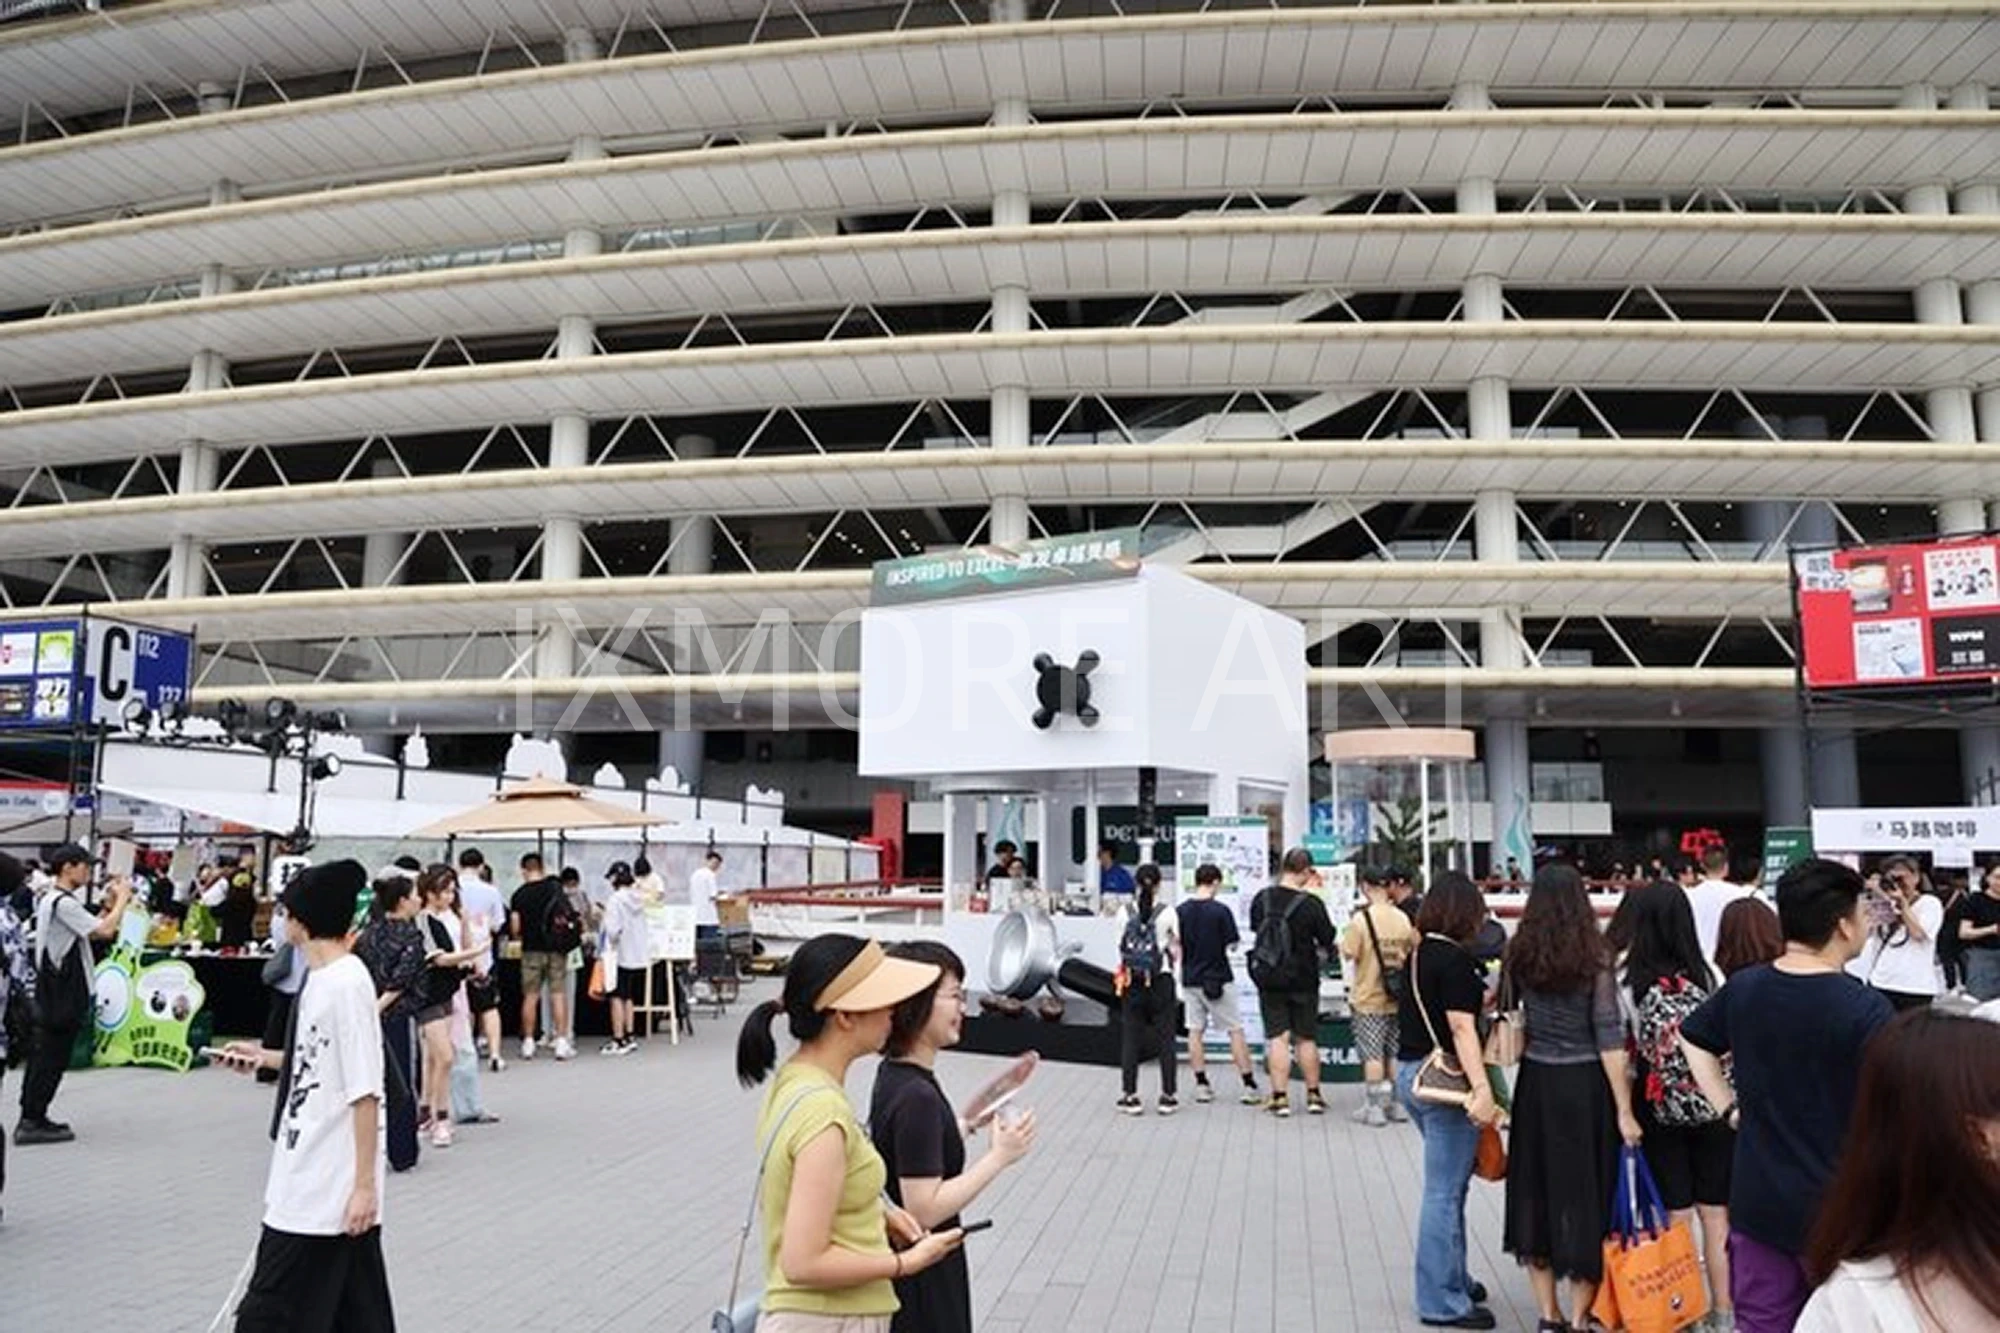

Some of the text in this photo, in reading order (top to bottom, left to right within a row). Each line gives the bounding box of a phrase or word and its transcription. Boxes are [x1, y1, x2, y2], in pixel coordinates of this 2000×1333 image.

[886, 563, 945, 586] INSPIRED
[947, 560, 964, 578] TO
[138, 632, 160, 659] 112
[101, 626, 130, 701] C
[1890, 821, 1977, 839] 马路咖啡
